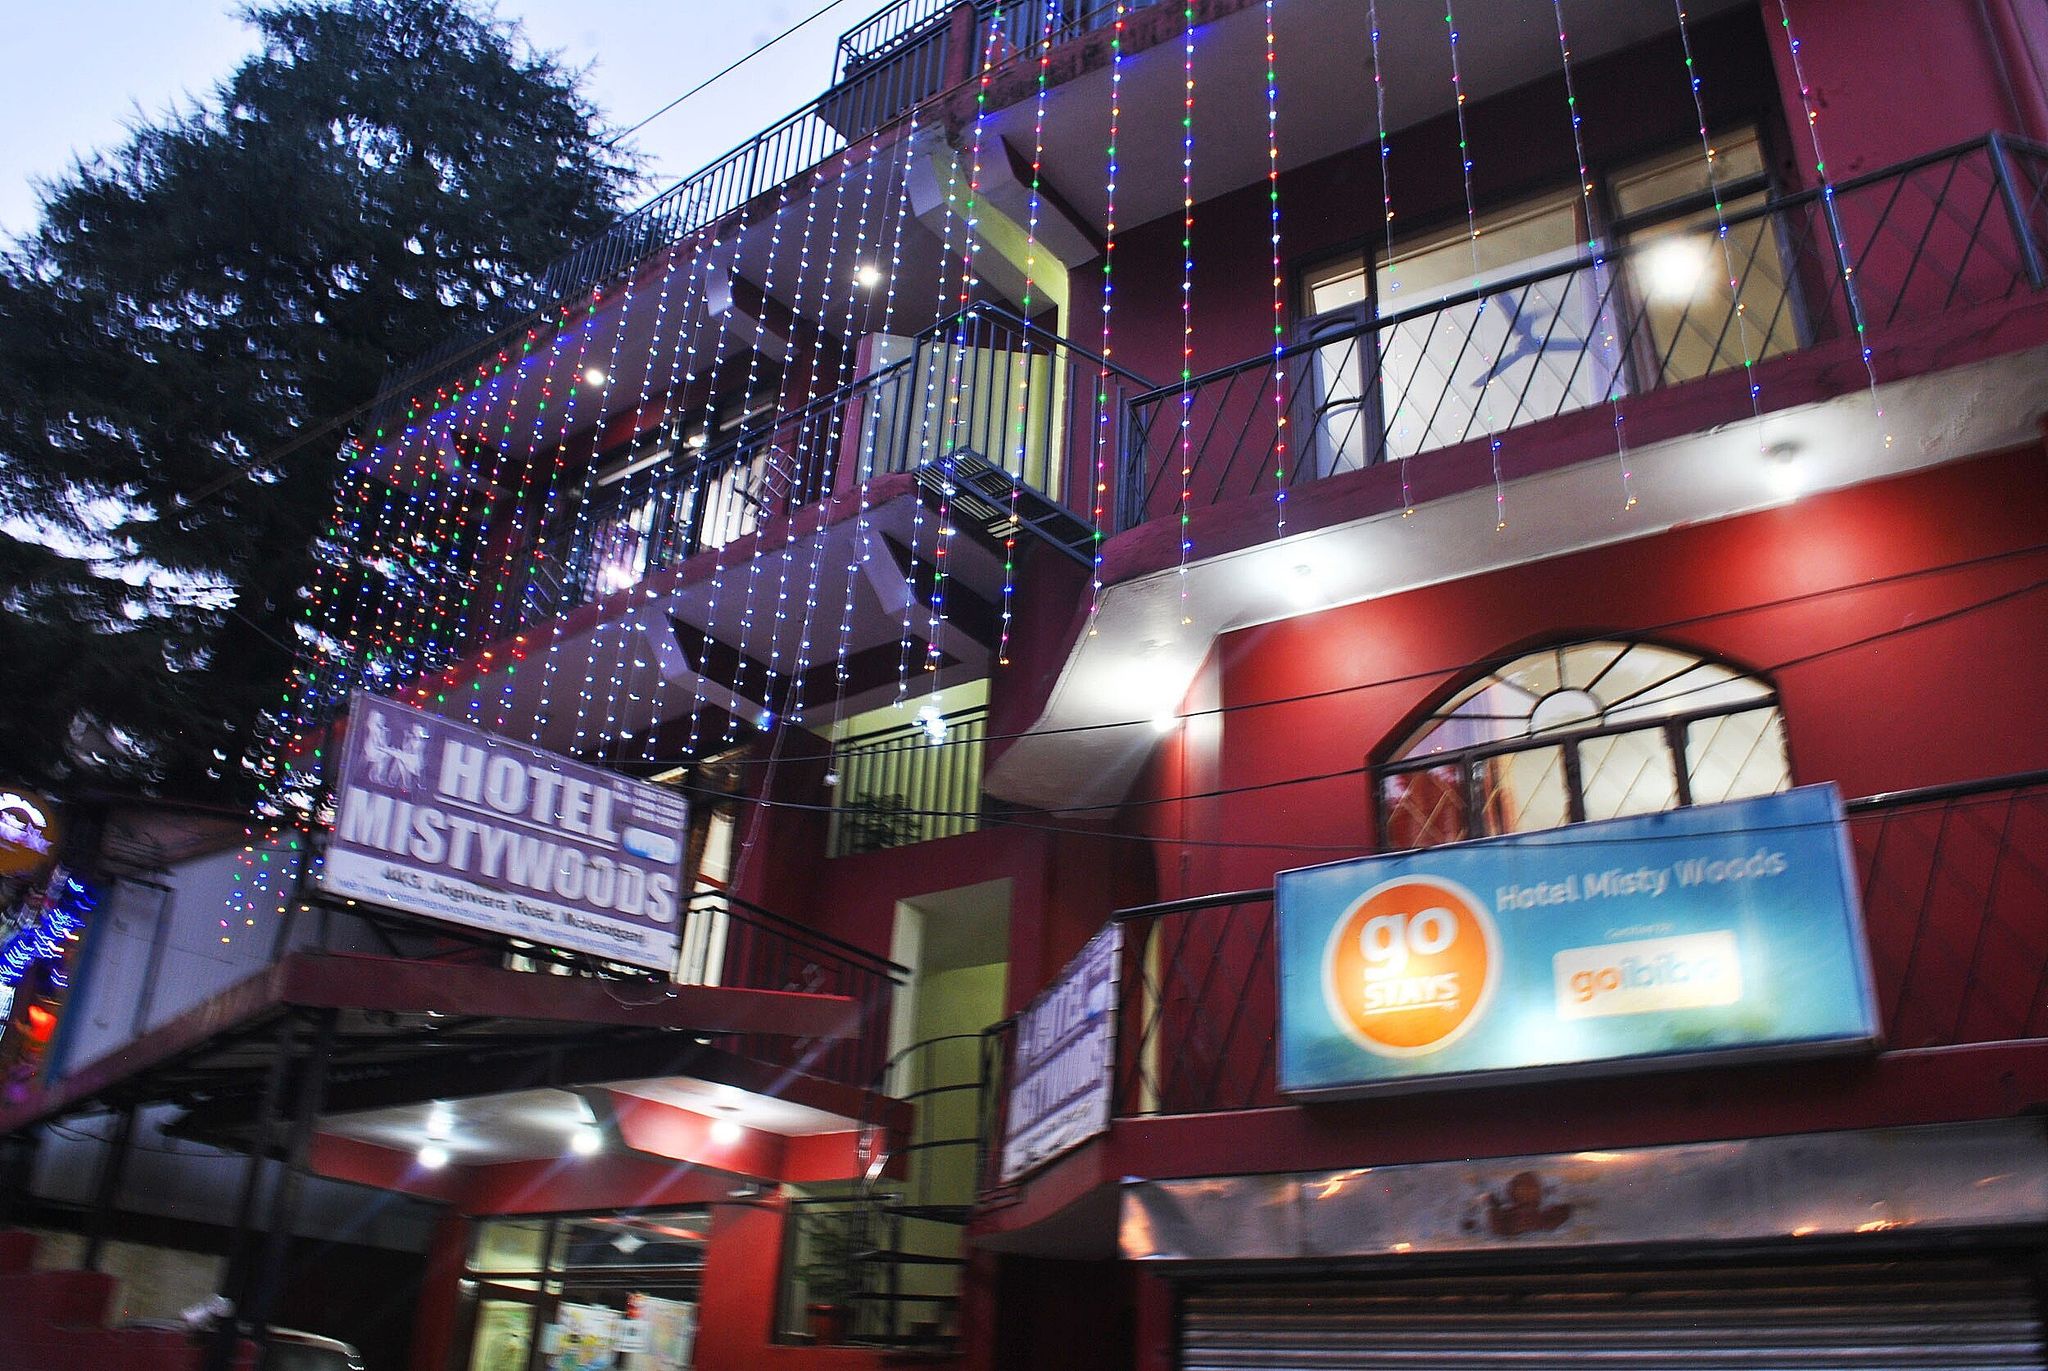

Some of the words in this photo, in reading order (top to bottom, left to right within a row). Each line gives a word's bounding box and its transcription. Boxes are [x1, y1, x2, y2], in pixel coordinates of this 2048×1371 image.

[437, 741, 621, 843] HOTEL
[338, 786, 676, 924] MISTYWOODS
[1495, 874, 1579, 913] Hotel
[1583, 865, 1671, 899] Misty
[1673, 846, 1788, 888] Woods
[1359, 907, 1459, 979] go
[1364, 972, 1460, 1008] STAYS
